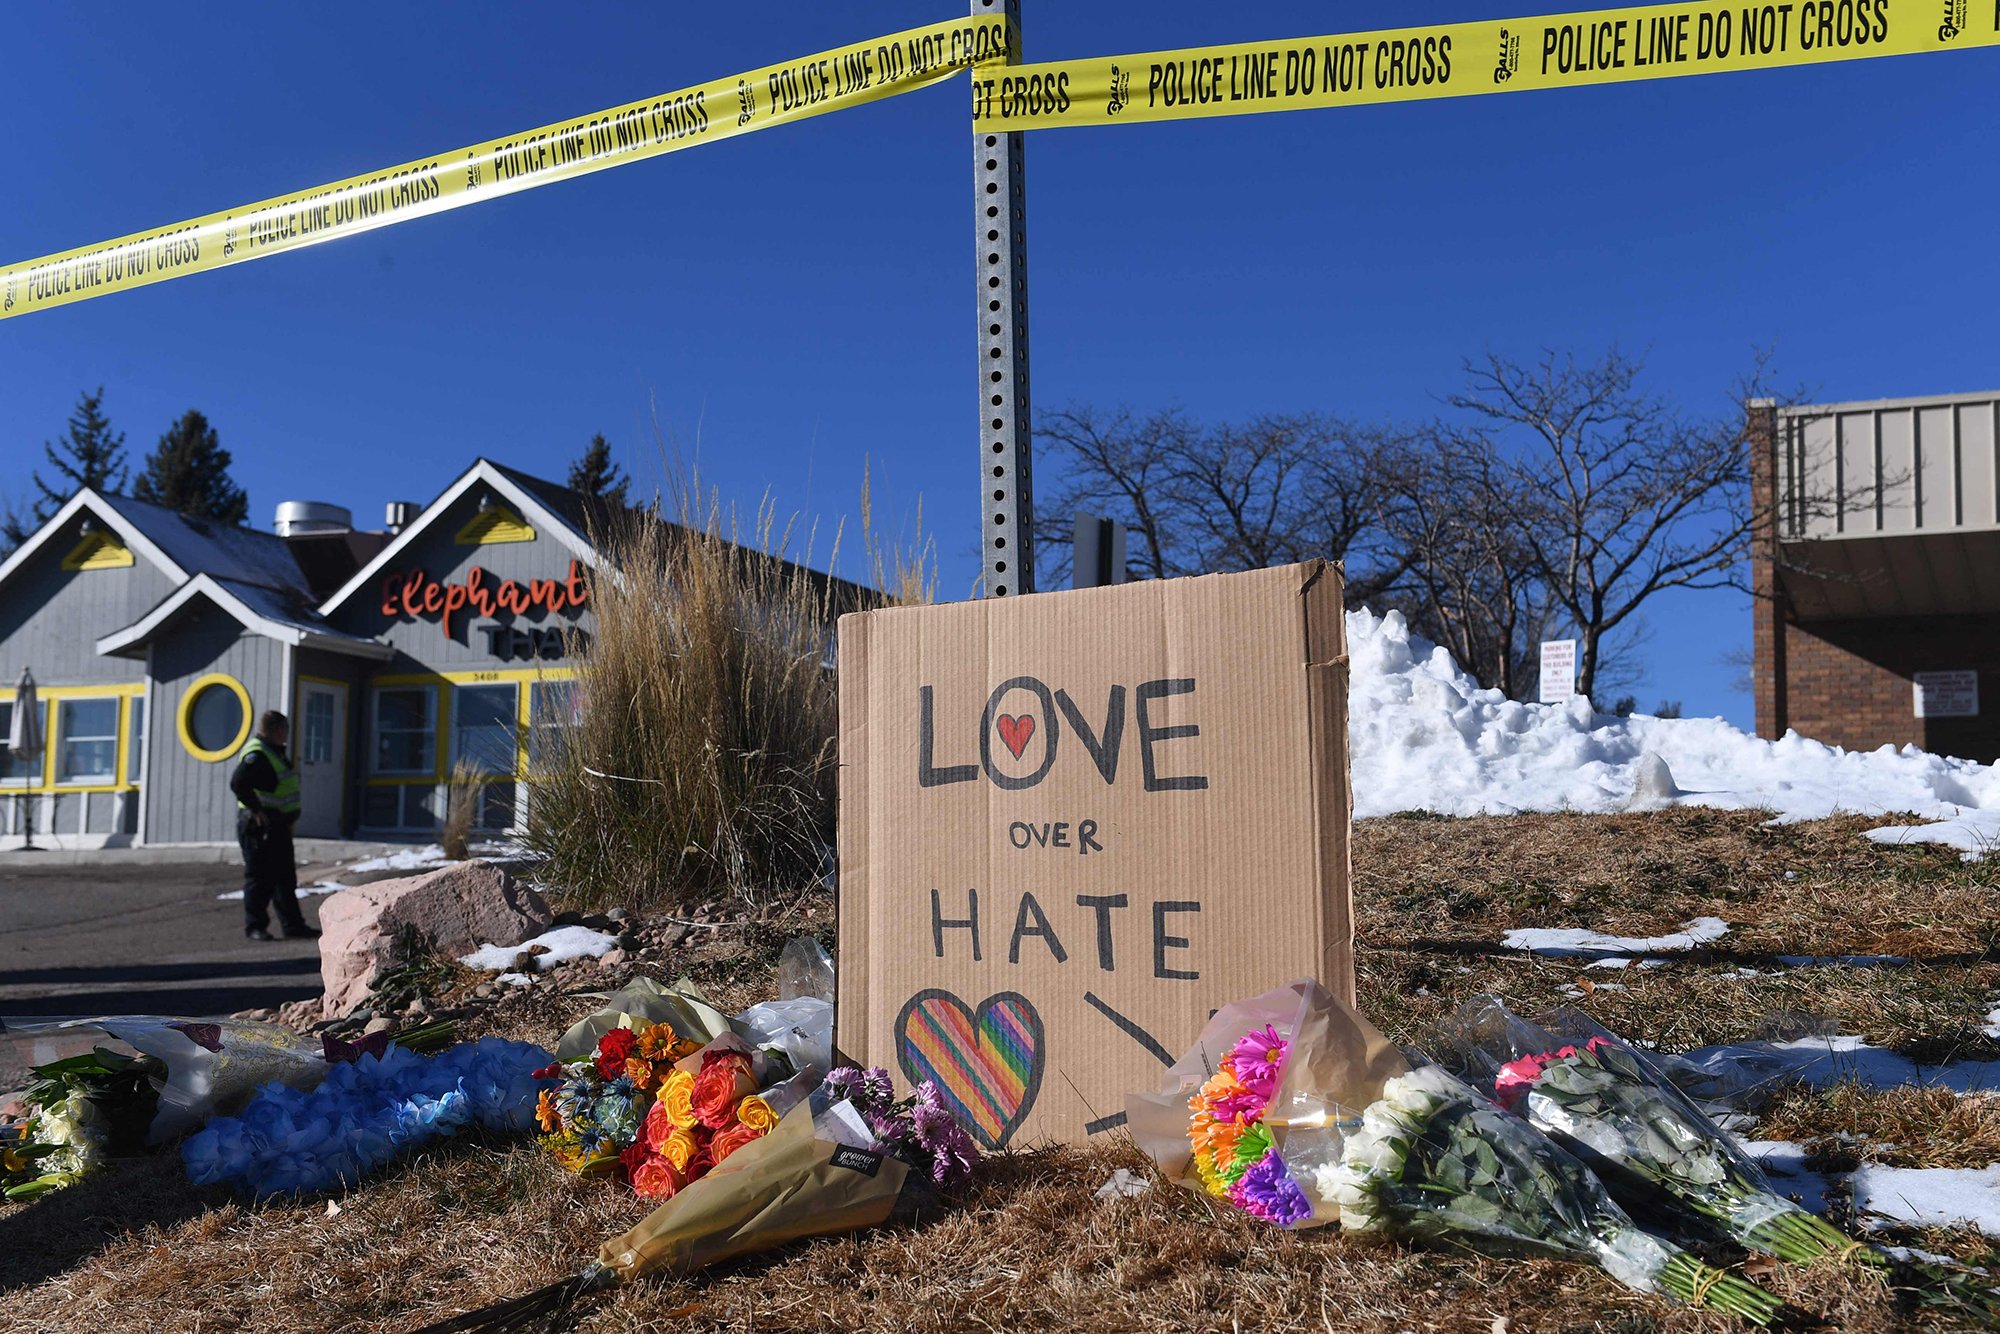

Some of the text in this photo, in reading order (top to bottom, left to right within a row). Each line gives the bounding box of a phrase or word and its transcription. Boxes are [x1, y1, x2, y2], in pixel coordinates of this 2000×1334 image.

[1494, 28, 1512, 84] GALLS
[1541, 0, 1889, 75] POLICE LINE DO NOT CROSS
[1938, 0, 1960, 42] GALL
[738, 78, 751, 126] GALLS
[768, 57, 829, 114] POLICE
[833, 49, 874, 98] LINE
[876, 42, 905, 85] DO
[906, 33, 945, 78] NOT
[948, 24, 1012, 66] CROSS
[972, 71, 1070, 120] OT CROSS
[1107, 64, 1123, 116] GALLS
[1149, 57, 1224, 107] POLICE
[1230, 51, 1279, 101] LINE
[1285, 47, 1316, 97] DO
[1322, 42, 1369, 93] NOT
[1375, 35, 1452, 89] CROSS
[494, 134, 548, 183] POLICE
[551, 124, 586, 170] LINE
[589, 116, 613, 160] DO
[615, 106, 648, 153] NOT
[651, 90, 709, 144] CROSS
[250, 199, 297, 248] POLICE
[301, 190, 331, 235] LINE
[335, 184, 354, 226] DO
[359, 177, 388, 219] NOT
[391, 162, 440, 210] CROSS
[28, 256, 71, 302] POLICE
[74, 249, 102, 290] LINE
[106, 244, 123, 283] DO
[127, 236, 154, 277] NOT
[156, 224, 200, 270] CROSS
[382, 558, 588, 639] Elephant
[919, 676, 1208, 792] LOVE
[1009, 819, 1103, 855] OVER
[931, 889, 1201, 980] HATE
[838, 1151, 875, 1164] grower
[841, 1159, 869, 1170] BUNCH
